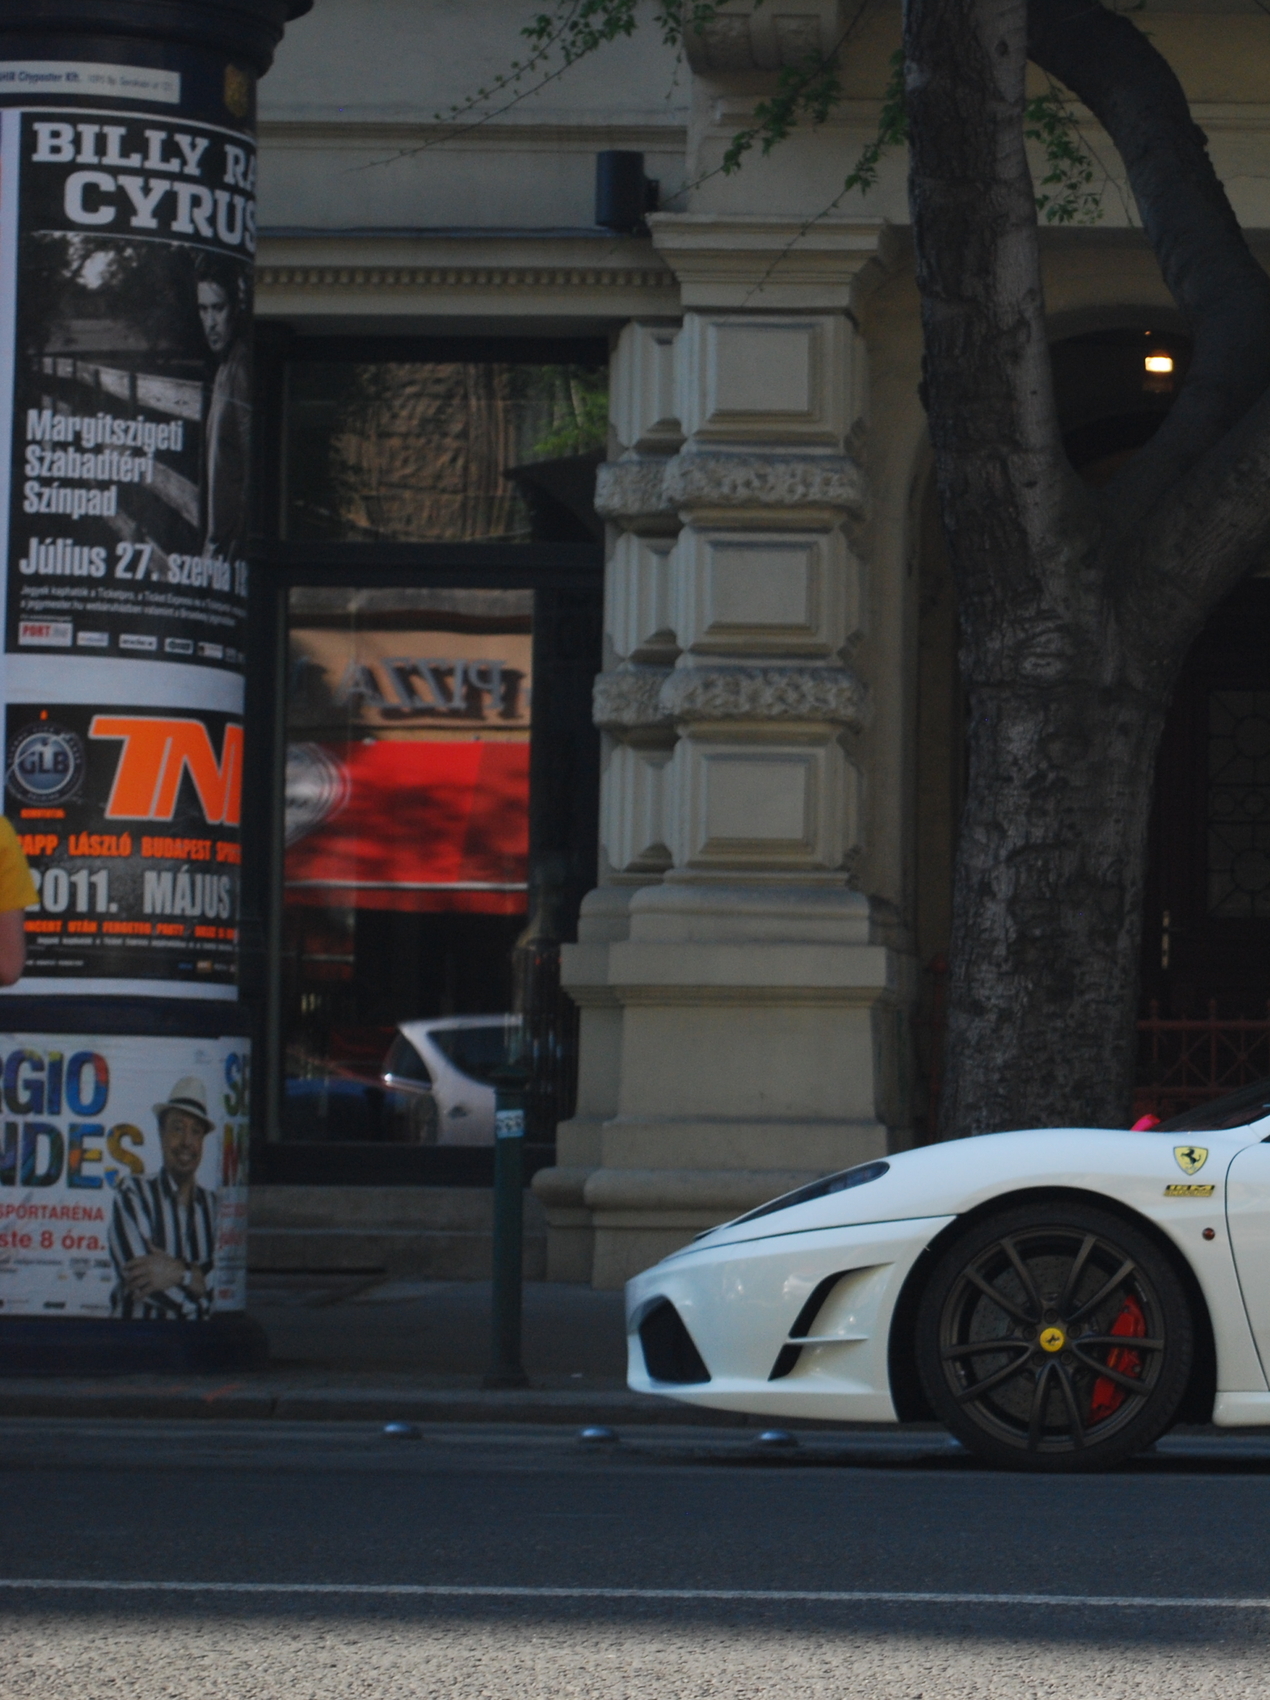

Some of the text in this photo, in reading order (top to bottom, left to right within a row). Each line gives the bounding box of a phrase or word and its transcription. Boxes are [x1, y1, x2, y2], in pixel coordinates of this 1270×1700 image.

[31, 121, 210, 176] BILLY
[63, 170, 256, 253] CYRUS
[26, 409, 184, 452] Margitszigeti
[24, 445, 155, 484] Szabadtéri
[23, 480, 118, 519] Színpad
[19, 537, 107, 578] Július
[114, 541, 160, 581] 27.
[68, 831, 133, 857] LÁSZLÓ
[141, 836, 213, 861] BUDAPEST
[143, 864, 231, 919] MÁJUS
[0, 1048, 110, 1117] GIO
[40, 1230, 54, 1249] 8
[61, 1228, 106, 1251] óra.
